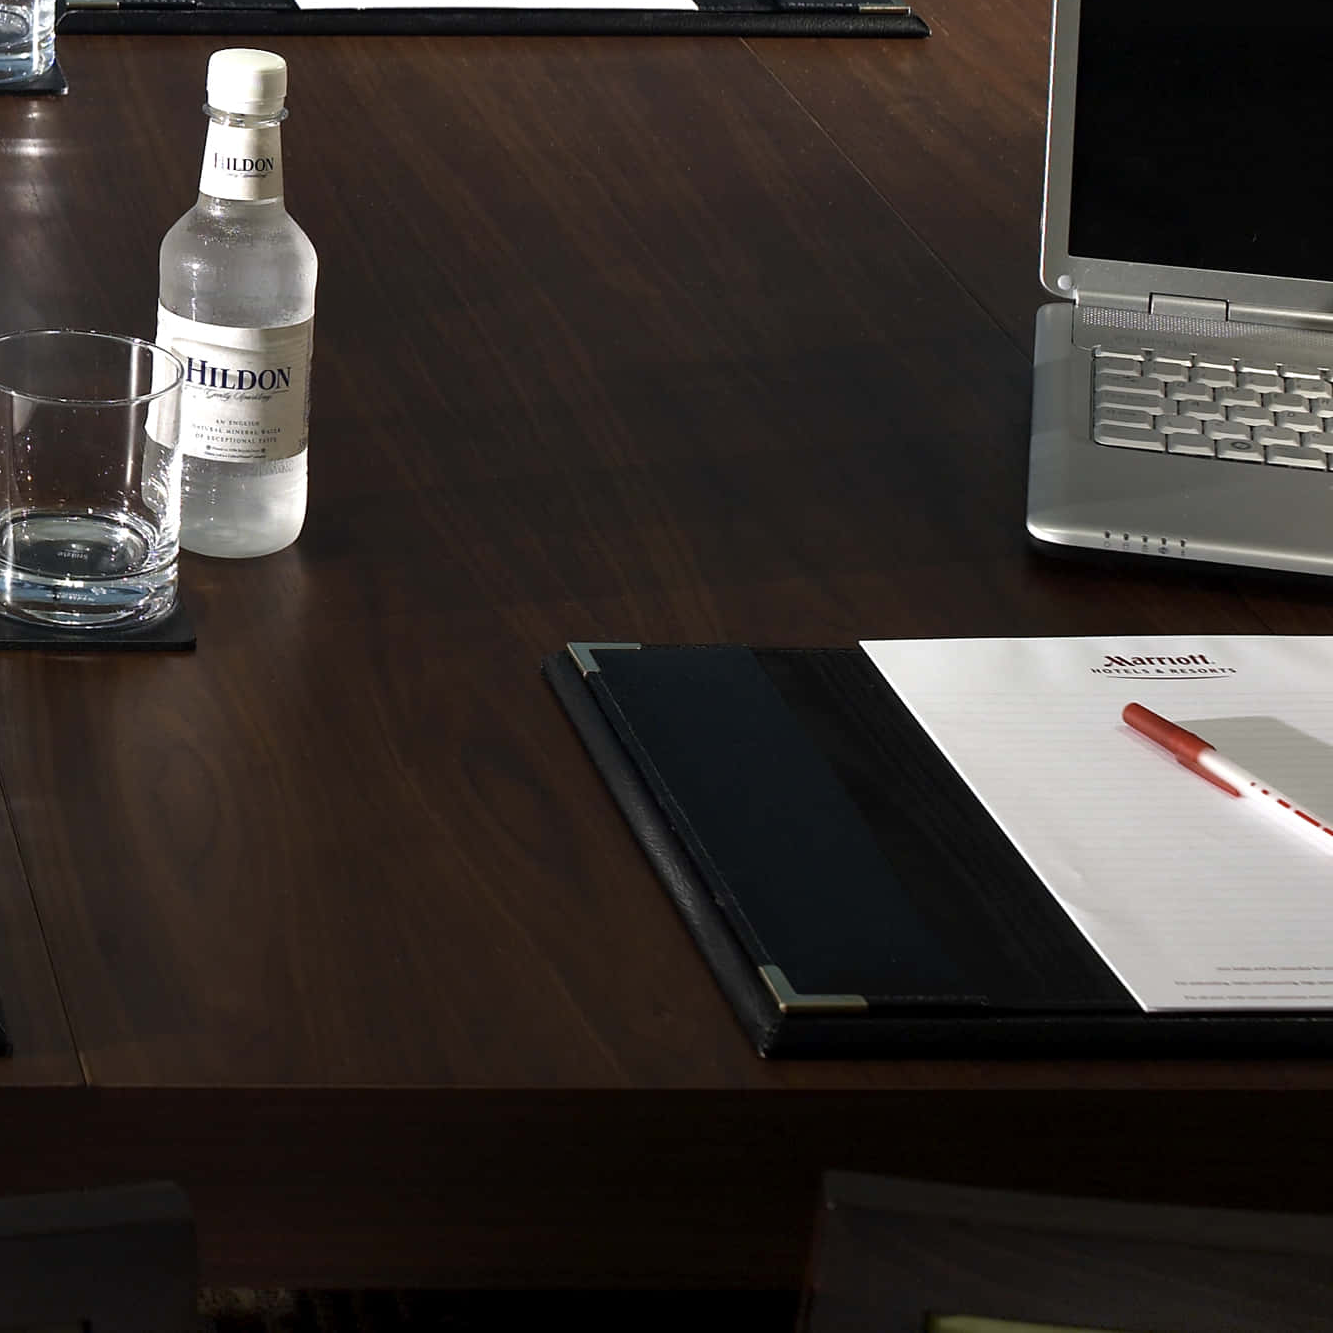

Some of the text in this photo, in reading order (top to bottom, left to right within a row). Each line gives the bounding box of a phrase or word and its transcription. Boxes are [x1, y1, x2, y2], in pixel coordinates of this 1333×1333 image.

[186, 356, 292, 391] HILDON
[1103, 654, 1210, 667] Marriott
[1091, 667, 1150, 675] HOTELS
